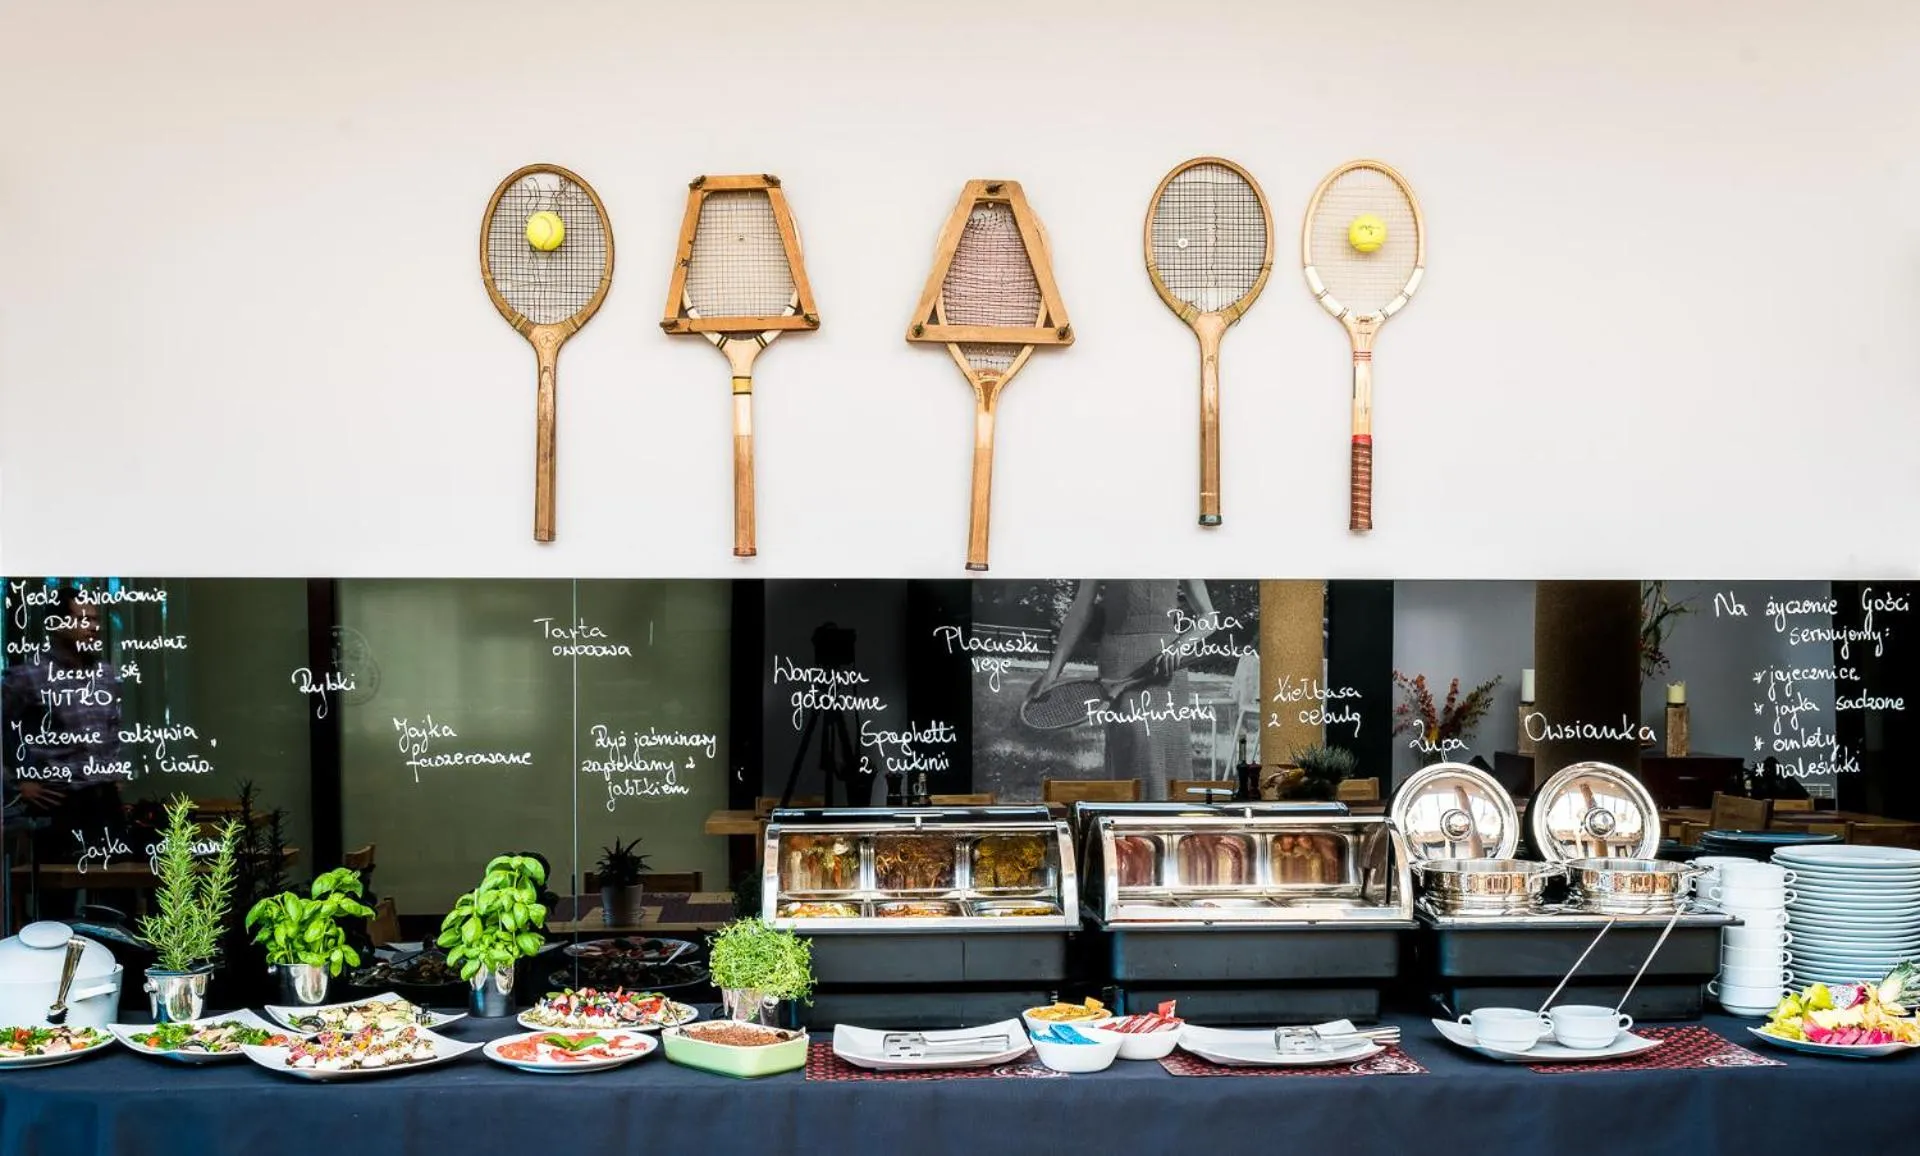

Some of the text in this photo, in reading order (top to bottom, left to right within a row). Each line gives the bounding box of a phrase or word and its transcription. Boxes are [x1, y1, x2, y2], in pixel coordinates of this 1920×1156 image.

[533, 617, 609, 639] Tarta
[1167, 608, 1244, 634] Biała
[1713, 587, 1911, 634] Na życzenie Gości
[7, 635, 188, 665] abyś nie musiał
[552, 645, 633, 657] owocowa
[933, 625, 1039, 654] Placuszki
[1160, 633, 1260, 660] kiełbaska
[47, 660, 142, 697] leczyć się
[773, 655, 870, 700] Warzywa
[971, 657, 1011, 692] vege
[1273, 674, 1363, 702] Kiełbasa
[291, 667, 356, 719] Rybki
[791, 684, 888, 731] gotowane
[1299, 704, 1361, 739] cebulą
[1524, 712, 1657, 742] Owsianka
[1773, 688, 1906, 736] jajka sadzone
[11, 720, 104, 761] Jedzenie
[392, 714, 458, 753] Jajka
[590, 724, 627, 763] Ryż
[860, 719, 957, 757] Spaghetti
[1409, 719, 1470, 763] Zupa
[1773, 726, 1840, 762] omlety
[16, 766, 73, 783] naszą
[83, 755, 134, 781] duszę
[143, 754, 149, 774] i
[406, 743, 533, 783] faszerowane
[886, 750, 950, 772] cukinii
[1776, 746, 1861, 779] naleśniki
[606, 777, 690, 812] jabłkiem
[71, 826, 134, 874] Jajka
